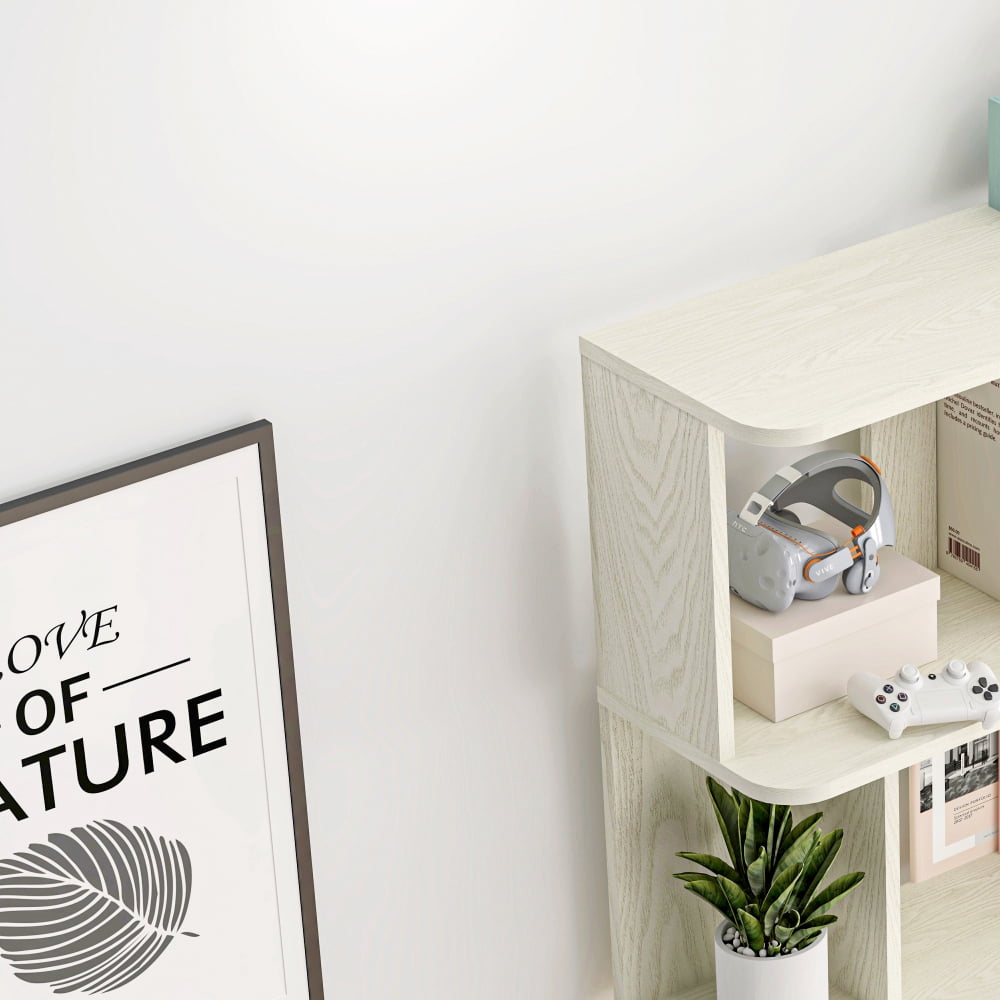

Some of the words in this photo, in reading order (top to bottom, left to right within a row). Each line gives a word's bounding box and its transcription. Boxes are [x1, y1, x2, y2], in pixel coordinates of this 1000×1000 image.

[815, 564, 833, 576] VIVE
[0, 604, 120, 680] OVE
[16, 671, 90, 736] OF
